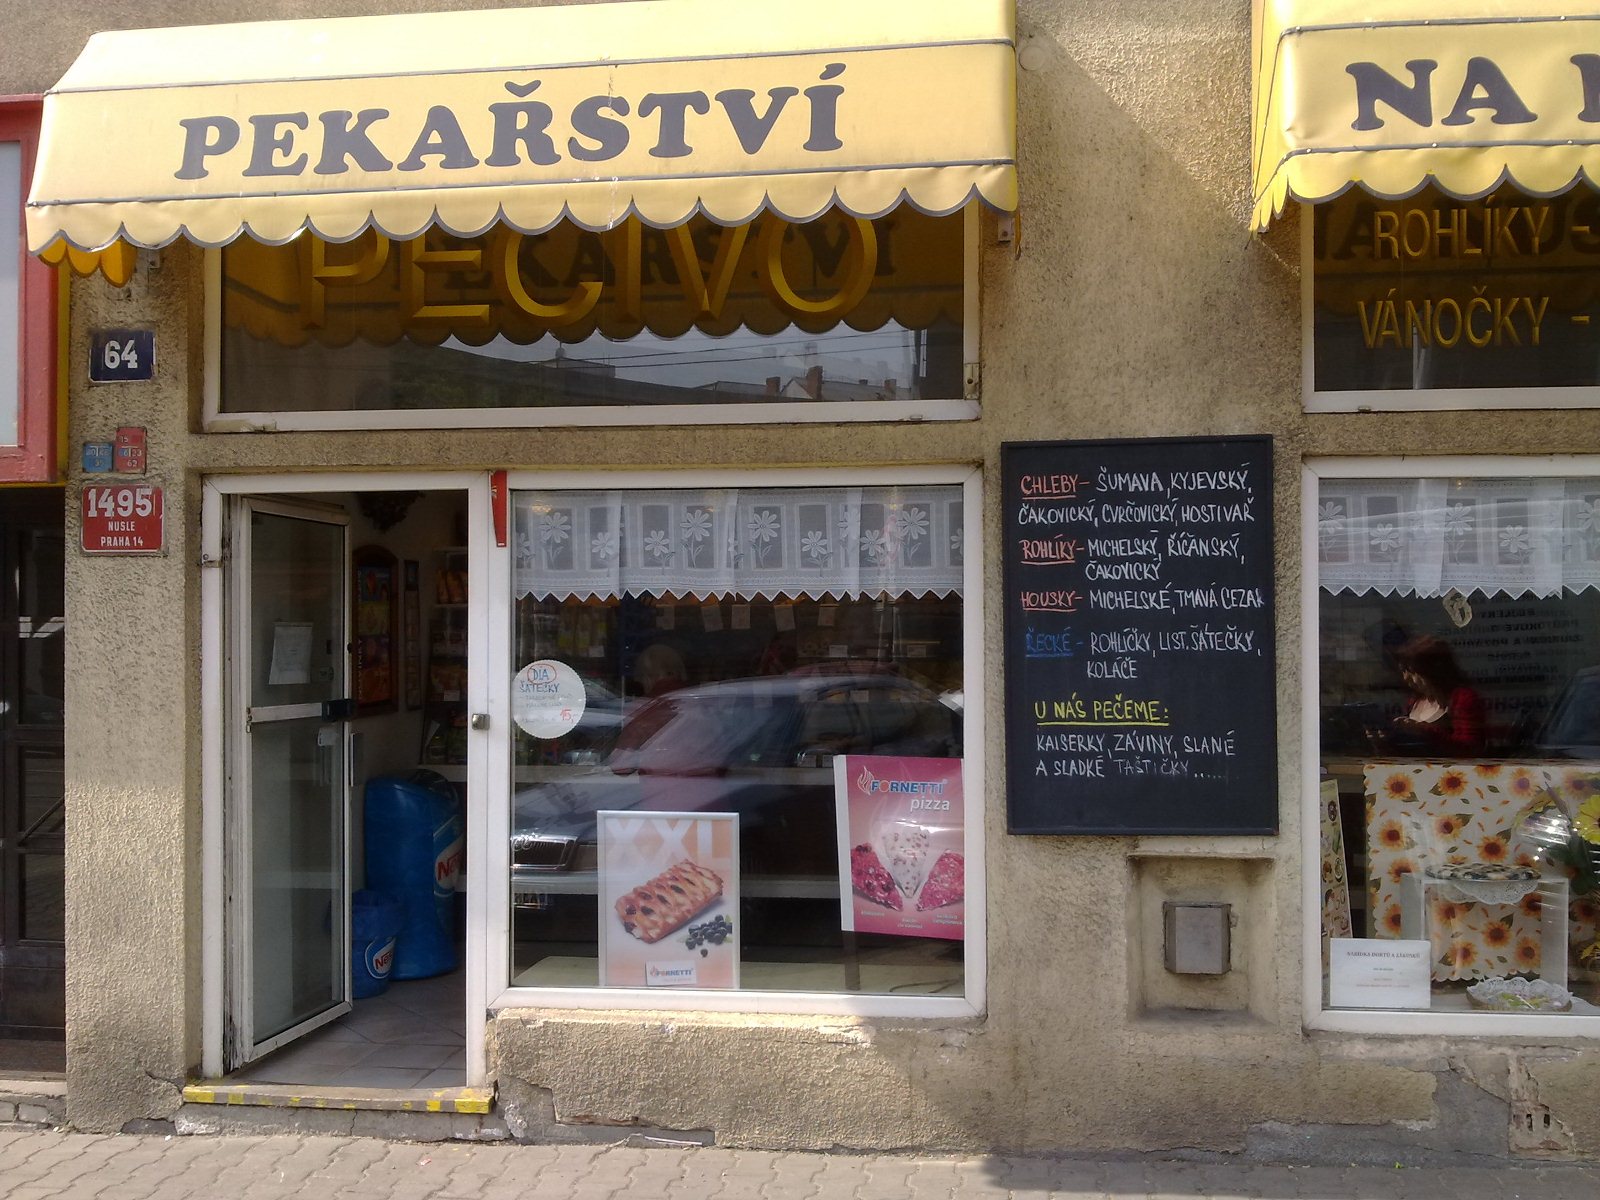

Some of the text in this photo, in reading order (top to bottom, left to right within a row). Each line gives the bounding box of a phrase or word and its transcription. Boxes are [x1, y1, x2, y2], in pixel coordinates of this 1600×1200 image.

[1345, 56, 1538, 131] NA
[173, 62, 847, 181] PEKAŘSTVÍ
[1373, 195, 1549, 260] ROHLÍKY
[1357, 286, 1549, 349] VÁNOČKY
[104, 339, 138, 369] 64
[88, 488, 152, 518] 1495
[1181, 496, 1255, 524] HOSTIVAŘ
[108, 521, 136, 532] NUSLE
[100, 536, 143, 547] PRAHA 14
[1085, 557, 1161, 581] ČAKOVICKÝ
[1174, 582, 1219, 609] TMAVÁ
[1087, 656, 1138, 680] KOLÁČE
[1034, 701, 1046, 719] U
[1054, 691, 1087, 720] NÁS
[1183, 729, 1236, 756] SLANÉ
[1035, 760, 1048, 777] A
[1053, 756, 1105, 778] SLADKÉ
[871, 780, 945, 795] FORNETTI
[910, 796, 950, 812] pizza
